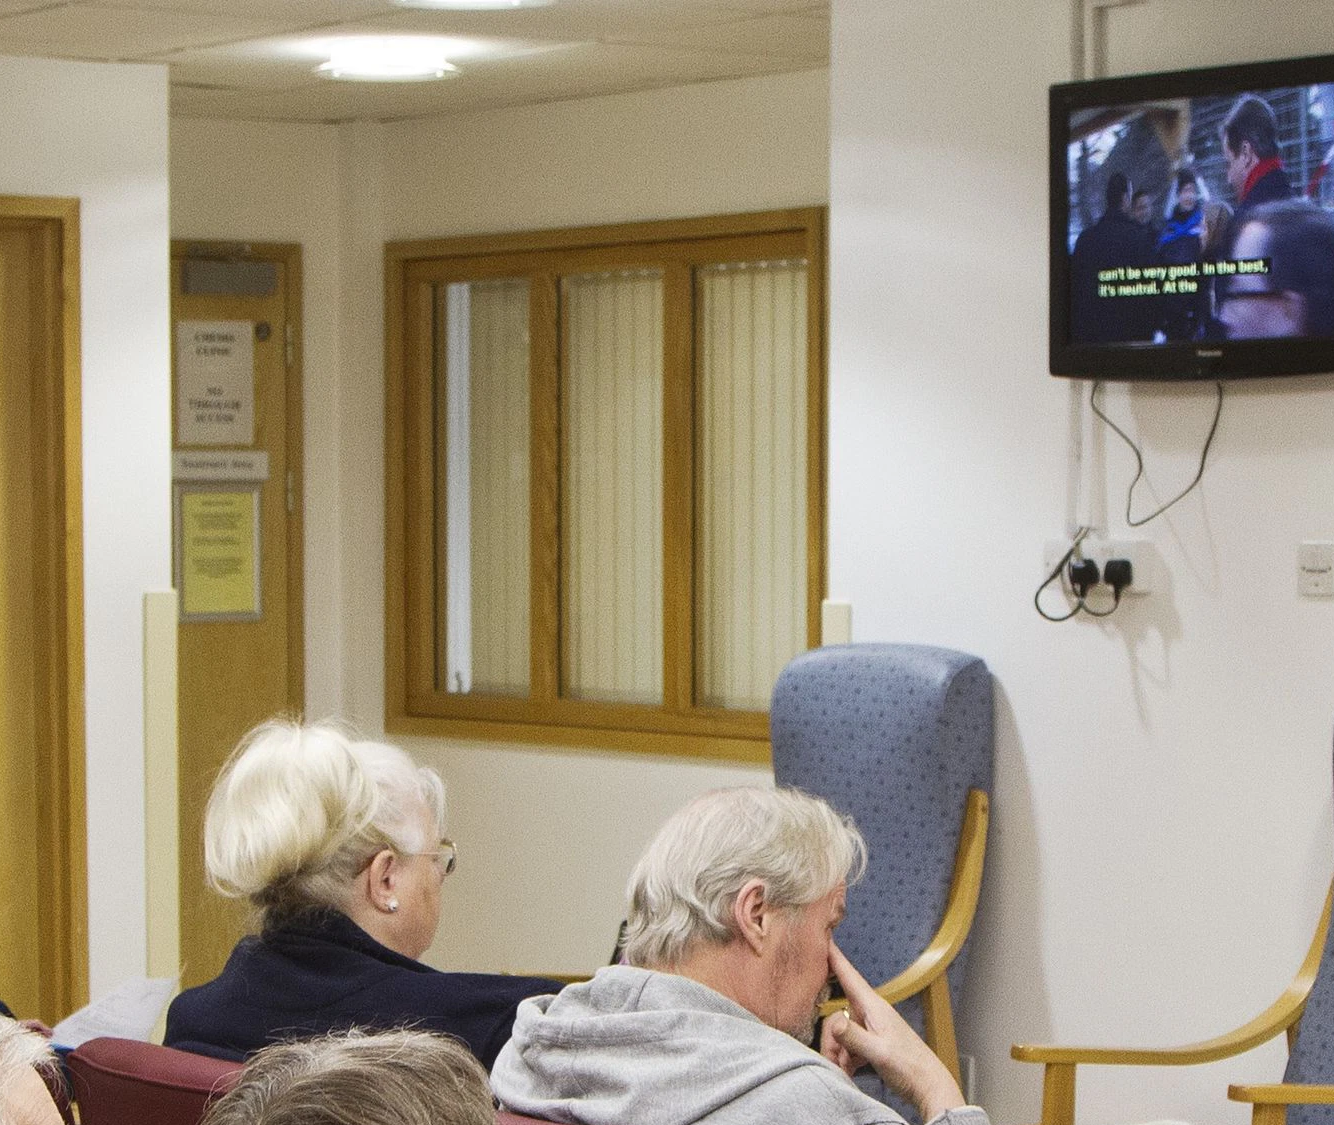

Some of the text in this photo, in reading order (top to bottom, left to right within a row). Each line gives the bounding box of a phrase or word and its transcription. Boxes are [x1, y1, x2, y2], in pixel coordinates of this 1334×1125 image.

[1098, 260, 1268, 281] can't be very good. In the best,
[1098, 280, 1197, 297] it's neutral. At the
